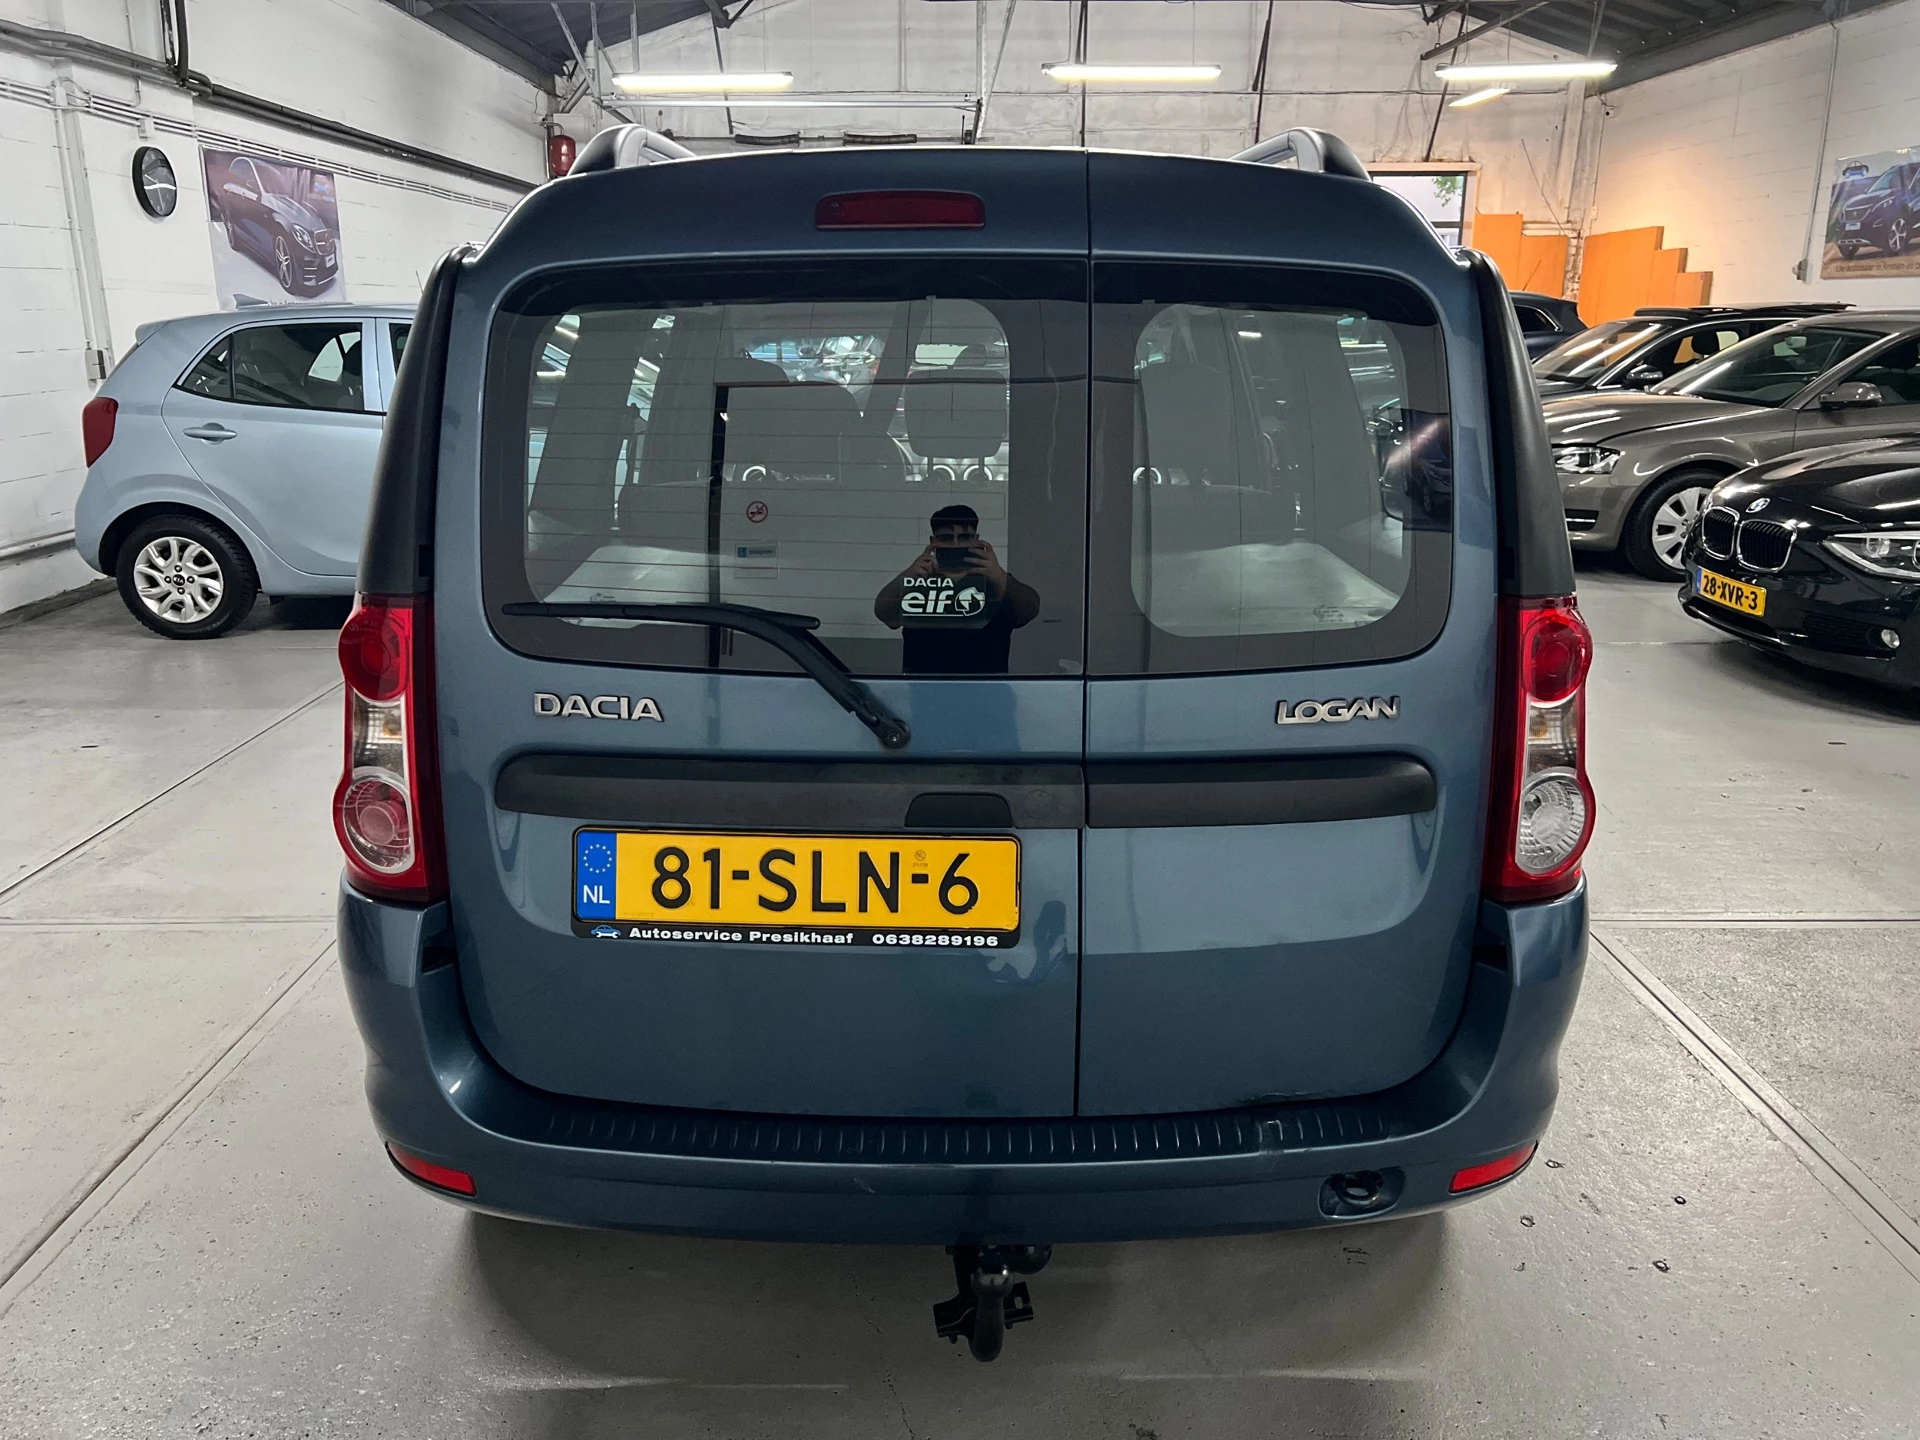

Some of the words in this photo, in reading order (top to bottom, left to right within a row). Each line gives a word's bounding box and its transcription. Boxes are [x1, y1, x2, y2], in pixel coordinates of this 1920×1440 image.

[904, 577, 954, 587] DACIA
[1703, 575, 1758, 610] 28-XVR-3
[901, 590, 954, 613] elf
[534, 692, 664, 722] DACIA
[1276, 696, 1401, 725] LOGAN
[652, 846, 979, 914] 81-SLN-6
[583, 884, 610, 904] NL
[630, 927, 743, 942] Autoservice
[749, 931, 854, 945] Presikhaaf
[872, 933, 998, 947] 0638289196
